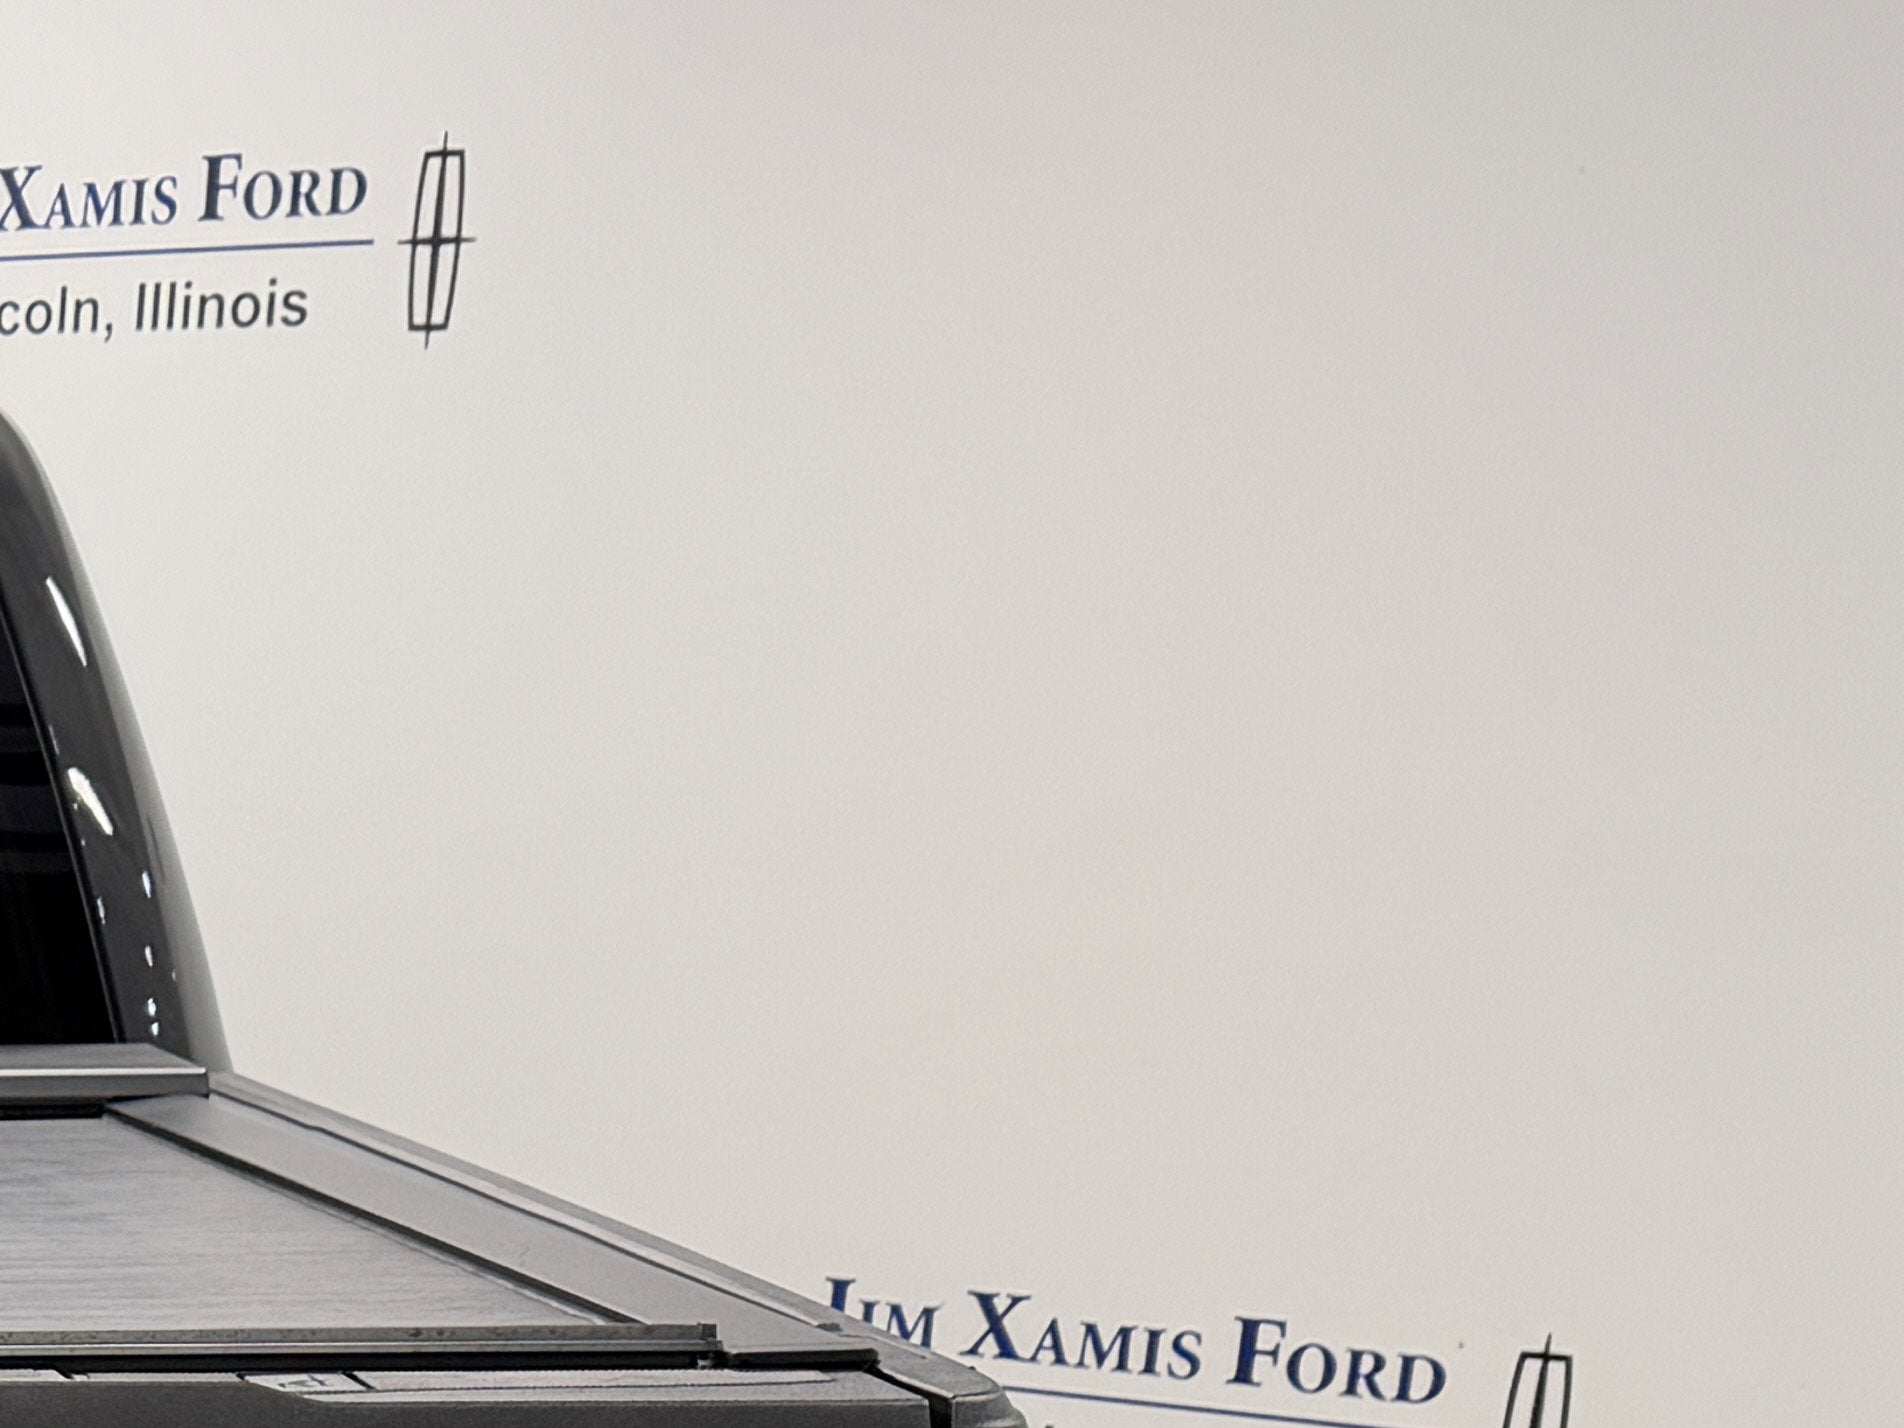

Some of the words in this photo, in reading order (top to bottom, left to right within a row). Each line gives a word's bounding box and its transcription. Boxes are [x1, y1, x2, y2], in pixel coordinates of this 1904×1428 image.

[199, 154, 366, 221] FORD
[136, 278, 307, 330] Illinois
[961, 1290, 1202, 1380] XAMIS
[1227, 1317, 1445, 1403] FORD
